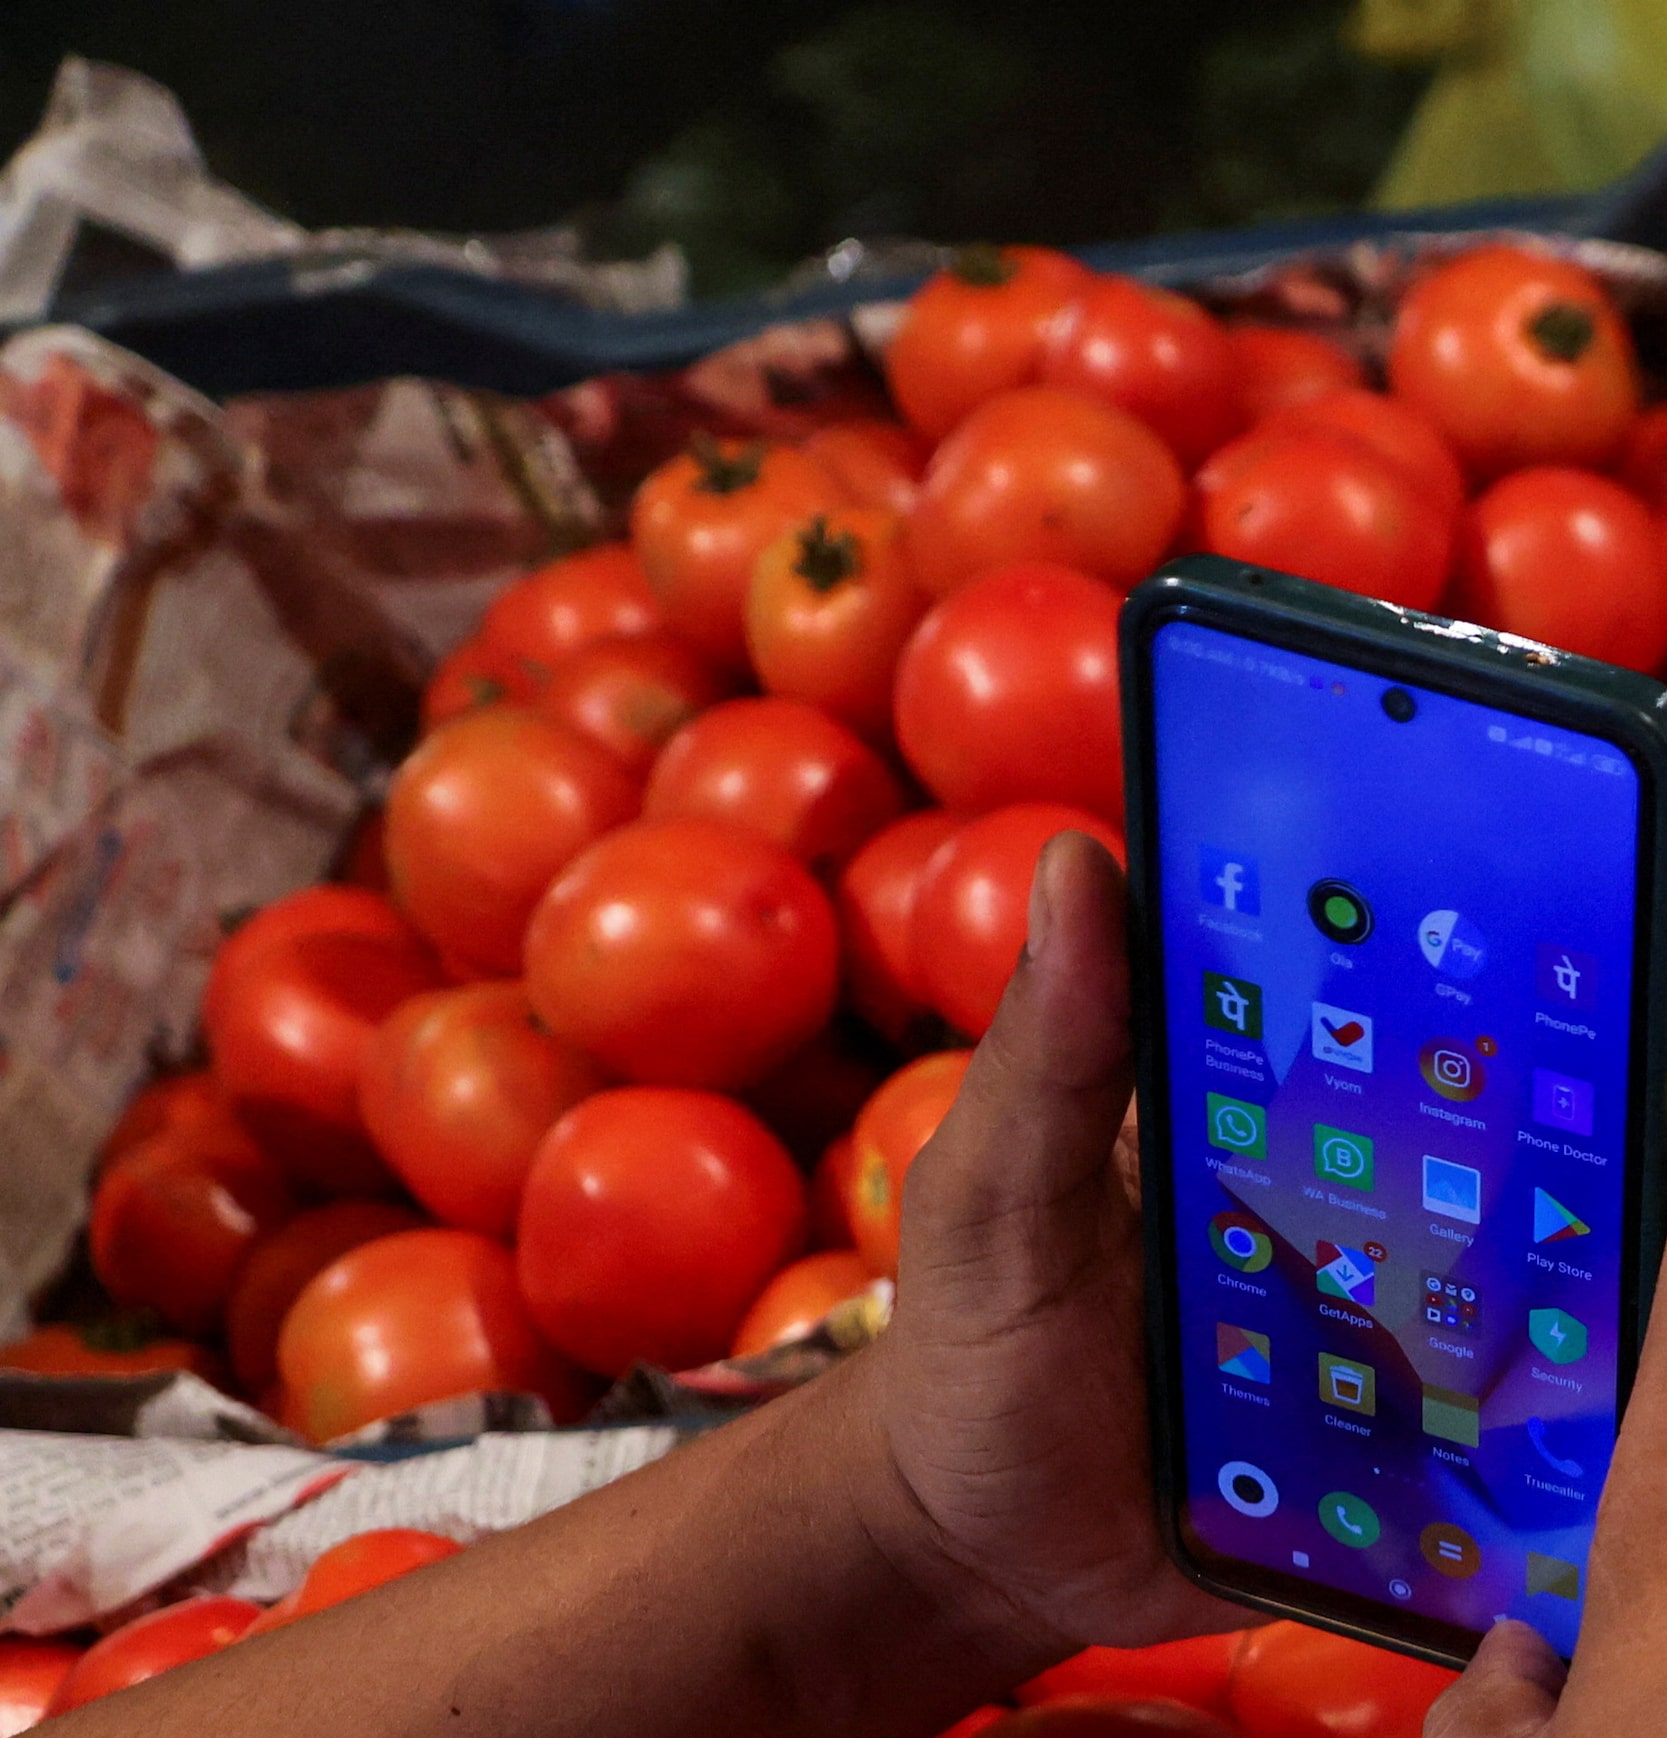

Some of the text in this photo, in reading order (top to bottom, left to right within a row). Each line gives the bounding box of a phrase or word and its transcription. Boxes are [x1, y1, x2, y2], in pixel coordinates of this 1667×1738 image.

[1329, 951, 1354, 970] Ola
[1452, 937, 1483, 962] Pay
[1552, 954, 1582, 1001] पे
[1215, 979, 1250, 1032] पे
[1434, 981, 1473, 1007] GPay
[1534, 1011, 1598, 1041] PhonePe
[1204, 1038, 1265, 1067] PhonePe
[1204, 1054, 1265, 1082] Business
[1323, 1072, 1363, 1096] Vyom
[1418, 1101, 1488, 1132] Instagram
[1516, 1130, 1609, 1168] Phone Doctor
[1204, 1155, 1273, 1188] WhatsApp
[1302, 1183, 1388, 1221] WA Business
[1428, 1222, 1475, 1249] Gallery
[1367, 1245, 1384, 1259] 22
[1526, 1251, 1594, 1282] Play Store
[1216, 1272, 1268, 1298] Chrome
[1318, 1302, 1374, 1330] GetApps
[1428, 1335, 1475, 1360] Google
[1530, 1366, 1584, 1394] Security
[1220, 1381, 1271, 1408] Themes
[1323, 1413, 1373, 1438] Cleaner
[1431, 1445, 1471, 1468] Notes
[1523, 1472, 1587, 1503] Truecaller
